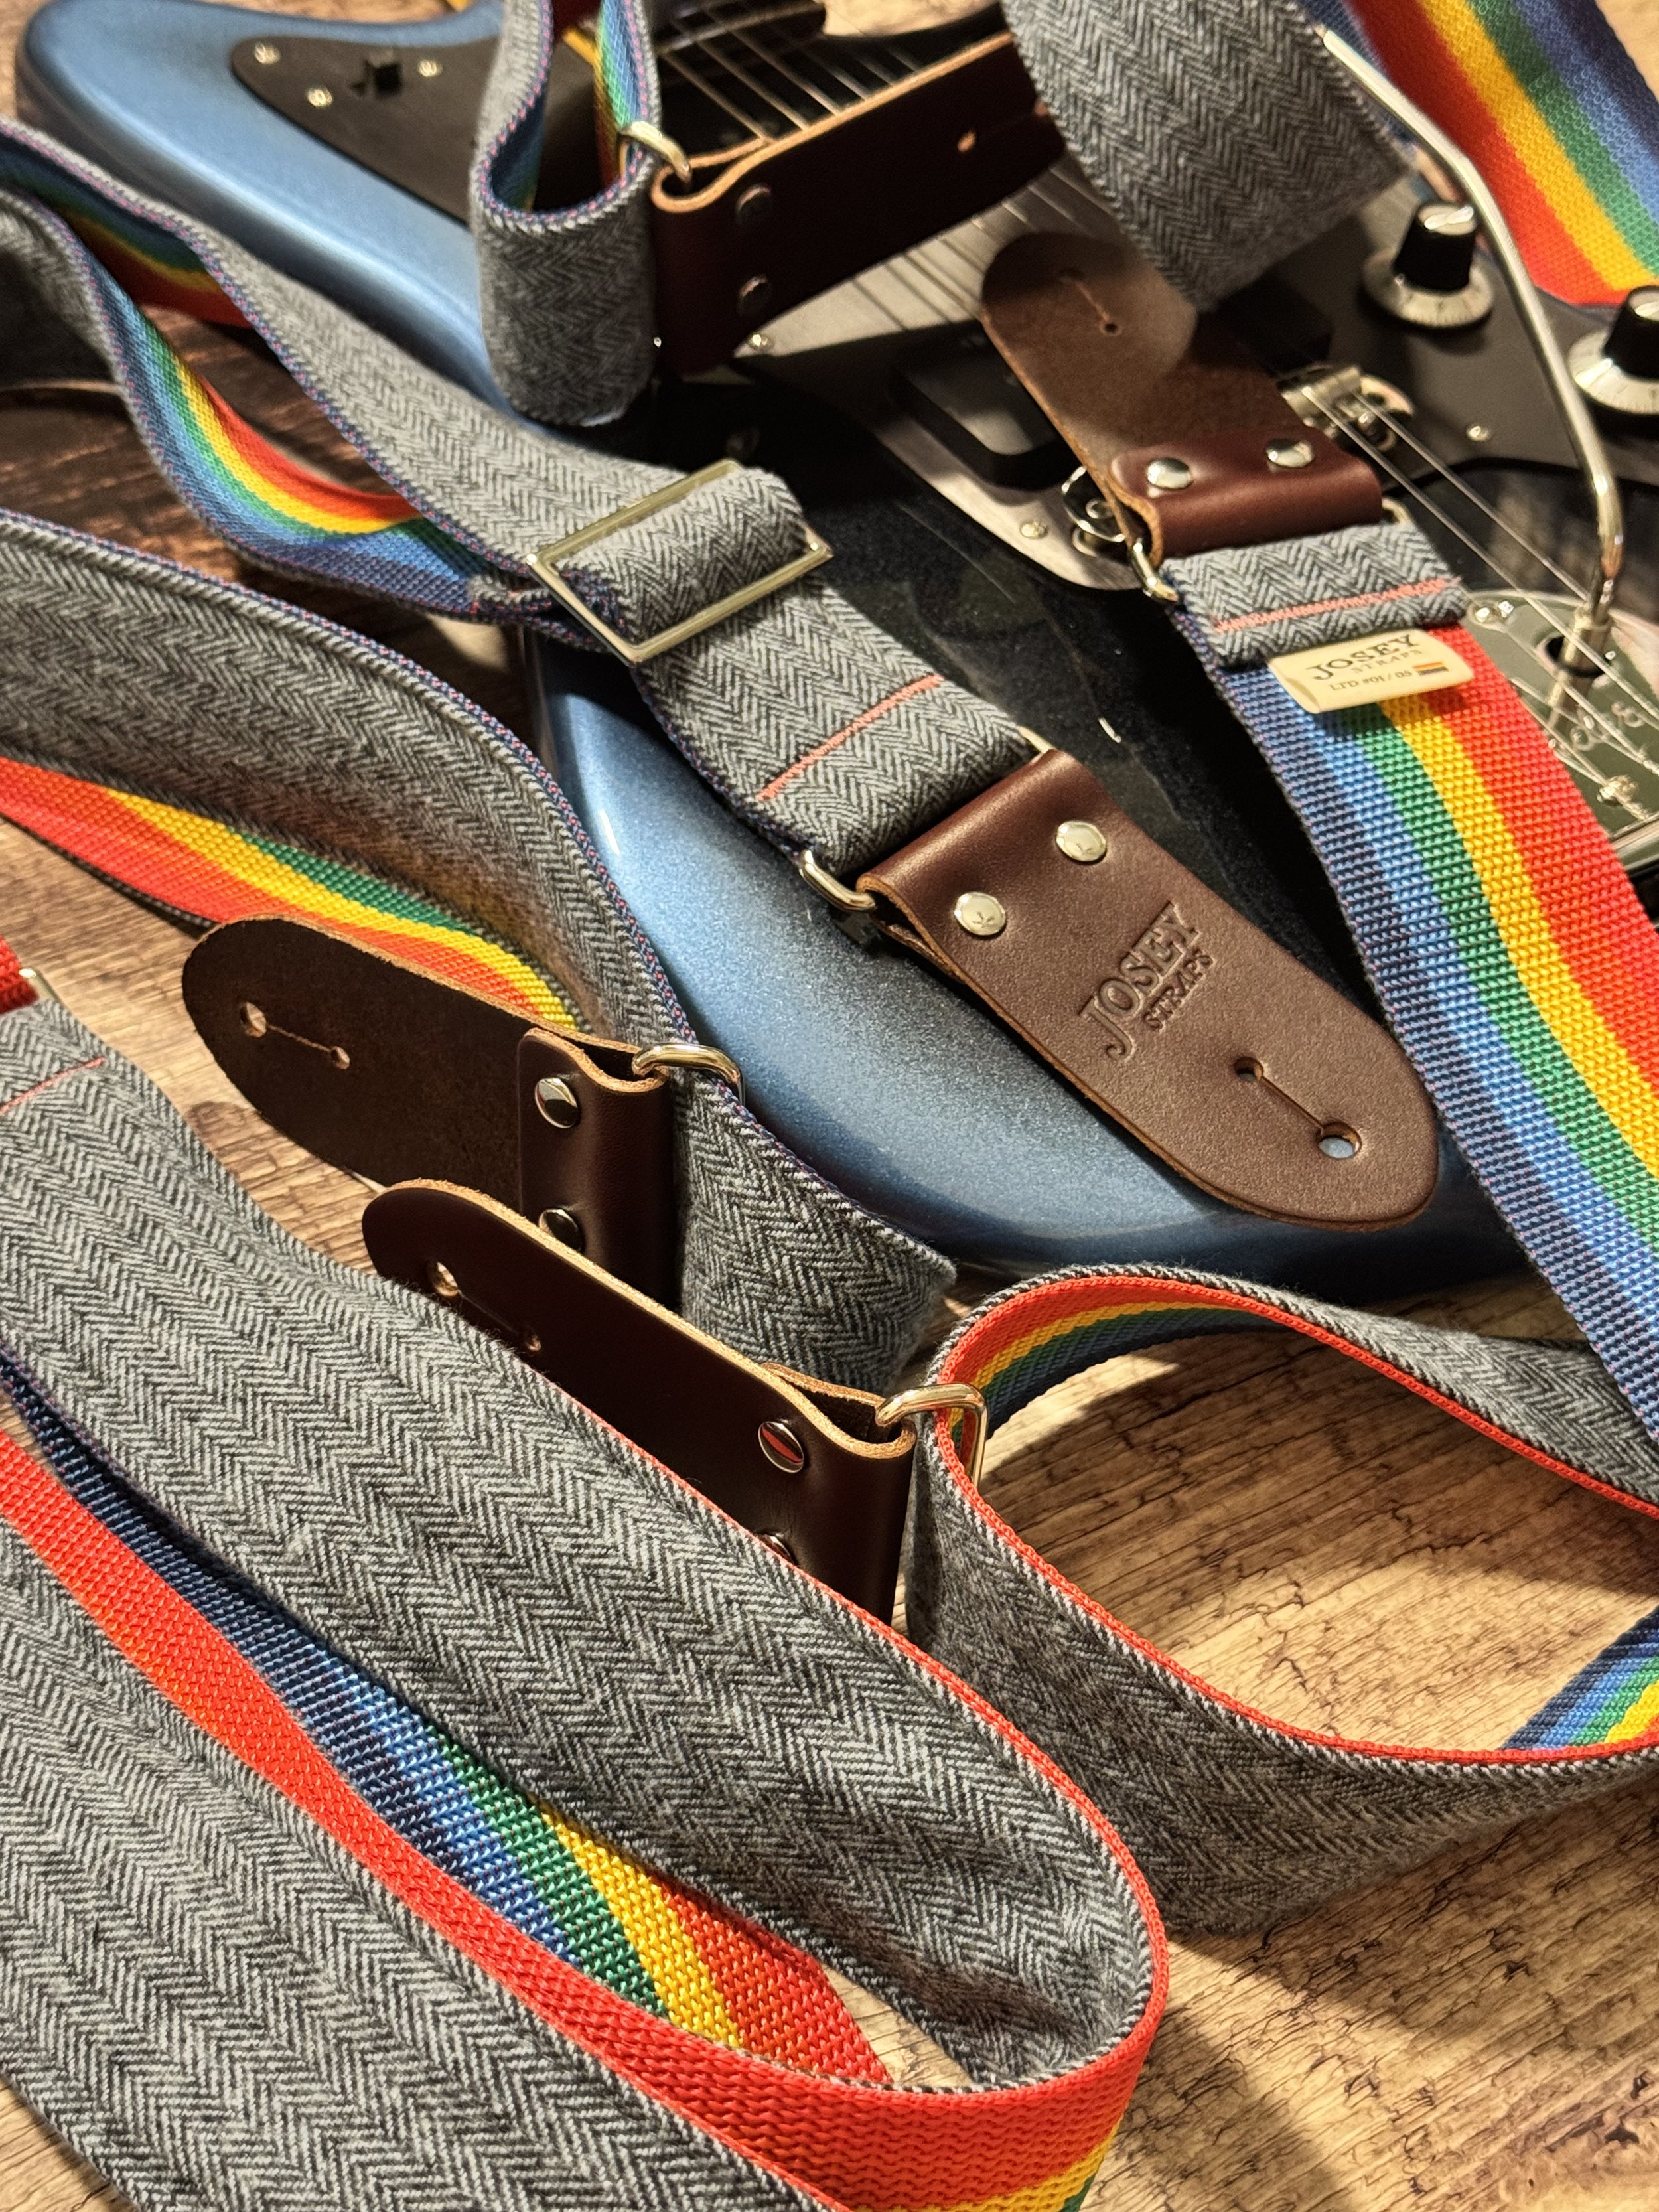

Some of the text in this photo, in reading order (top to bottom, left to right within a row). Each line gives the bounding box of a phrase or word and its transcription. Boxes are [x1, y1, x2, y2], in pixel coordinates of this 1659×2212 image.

[1305, 634, 1419, 680] JOSEY
[1351, 648, 1422, 673] STRAPS
[1329, 680, 1359, 691] LTD
[1078, 900, 1202, 1062] JOSEY
[1143, 947, 1214, 1032] STRAPS
